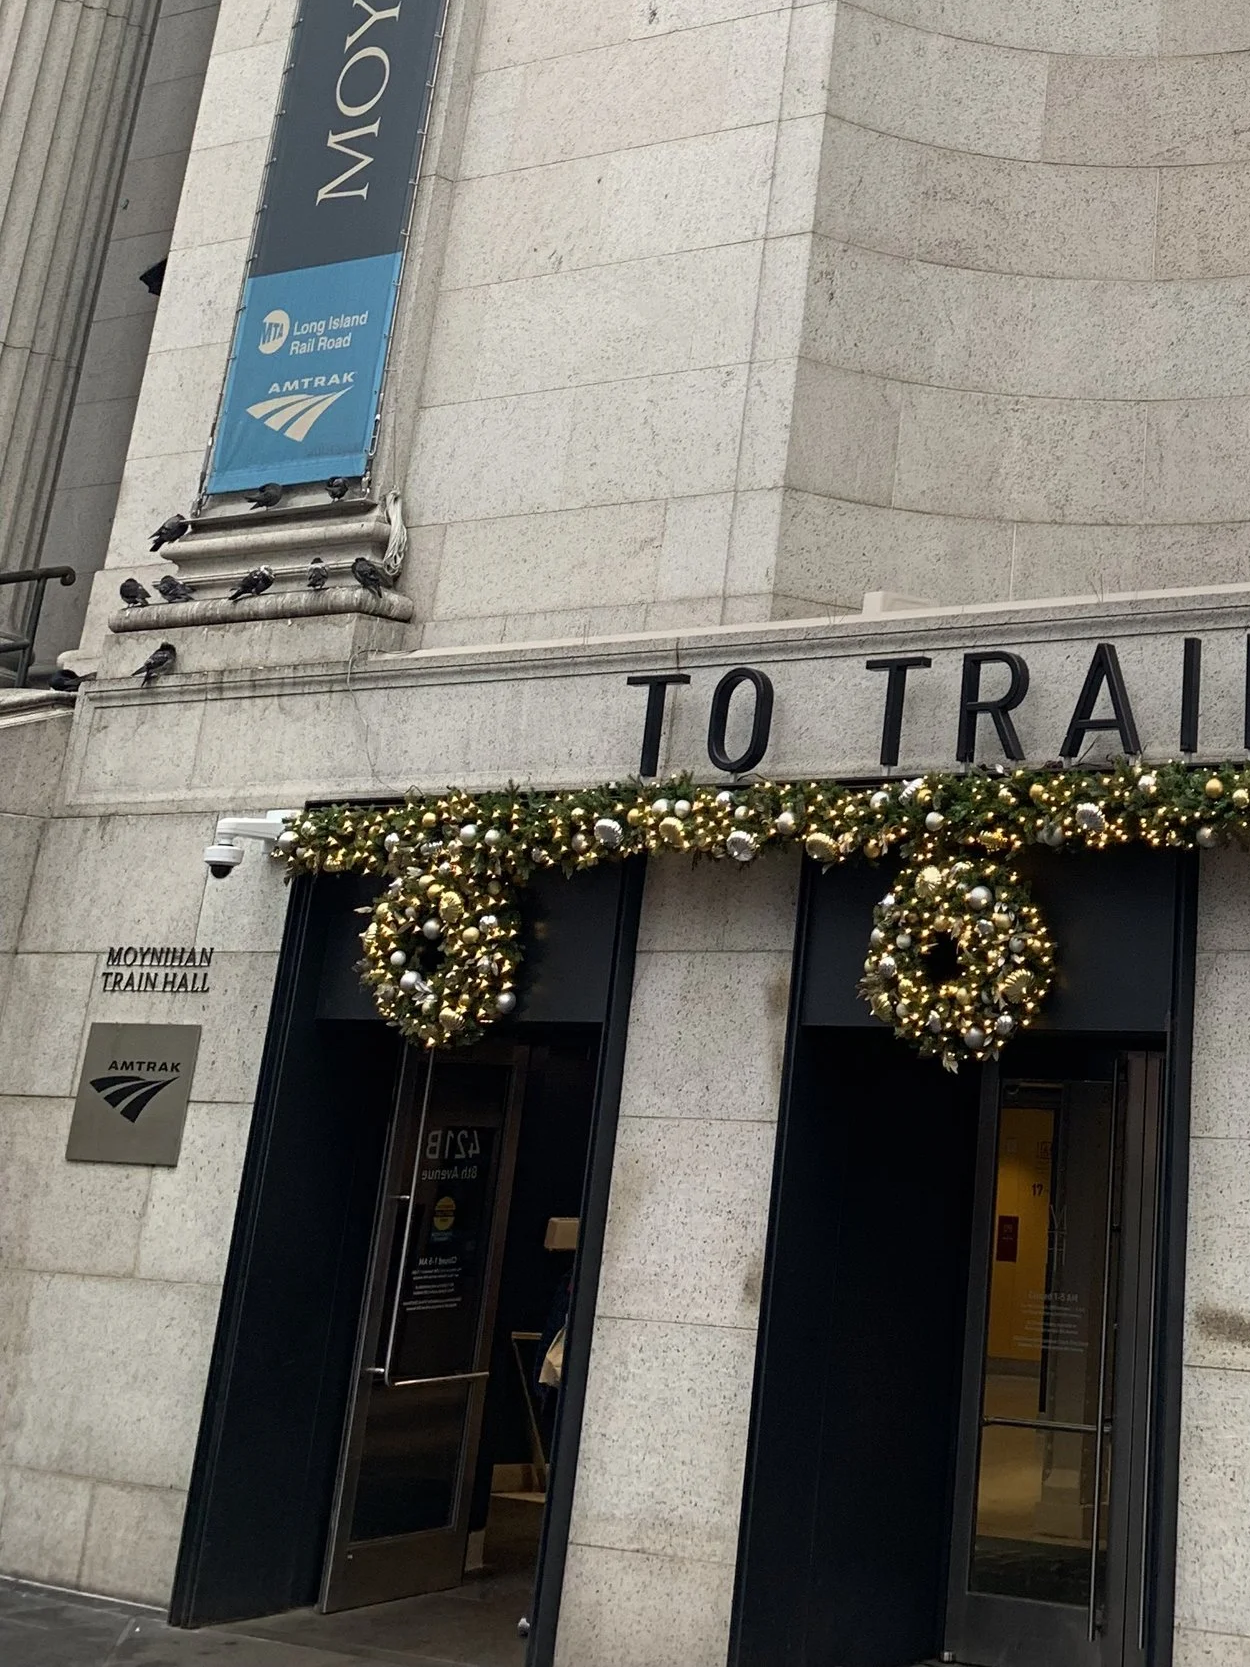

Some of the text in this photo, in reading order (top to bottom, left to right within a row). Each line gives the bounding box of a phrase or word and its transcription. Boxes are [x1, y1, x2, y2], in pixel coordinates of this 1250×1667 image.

[293, 311, 368, 336] Long Island
[289, 333, 351, 355] Rail Road
[268, 372, 355, 394] AMTRAK
[626, 667, 774, 777] TO
[106, 946, 214, 967] MOYNIHAN
[102, 972, 210, 993] TRAIN HALL
[108, 1060, 181, 1072] AMTRAK
